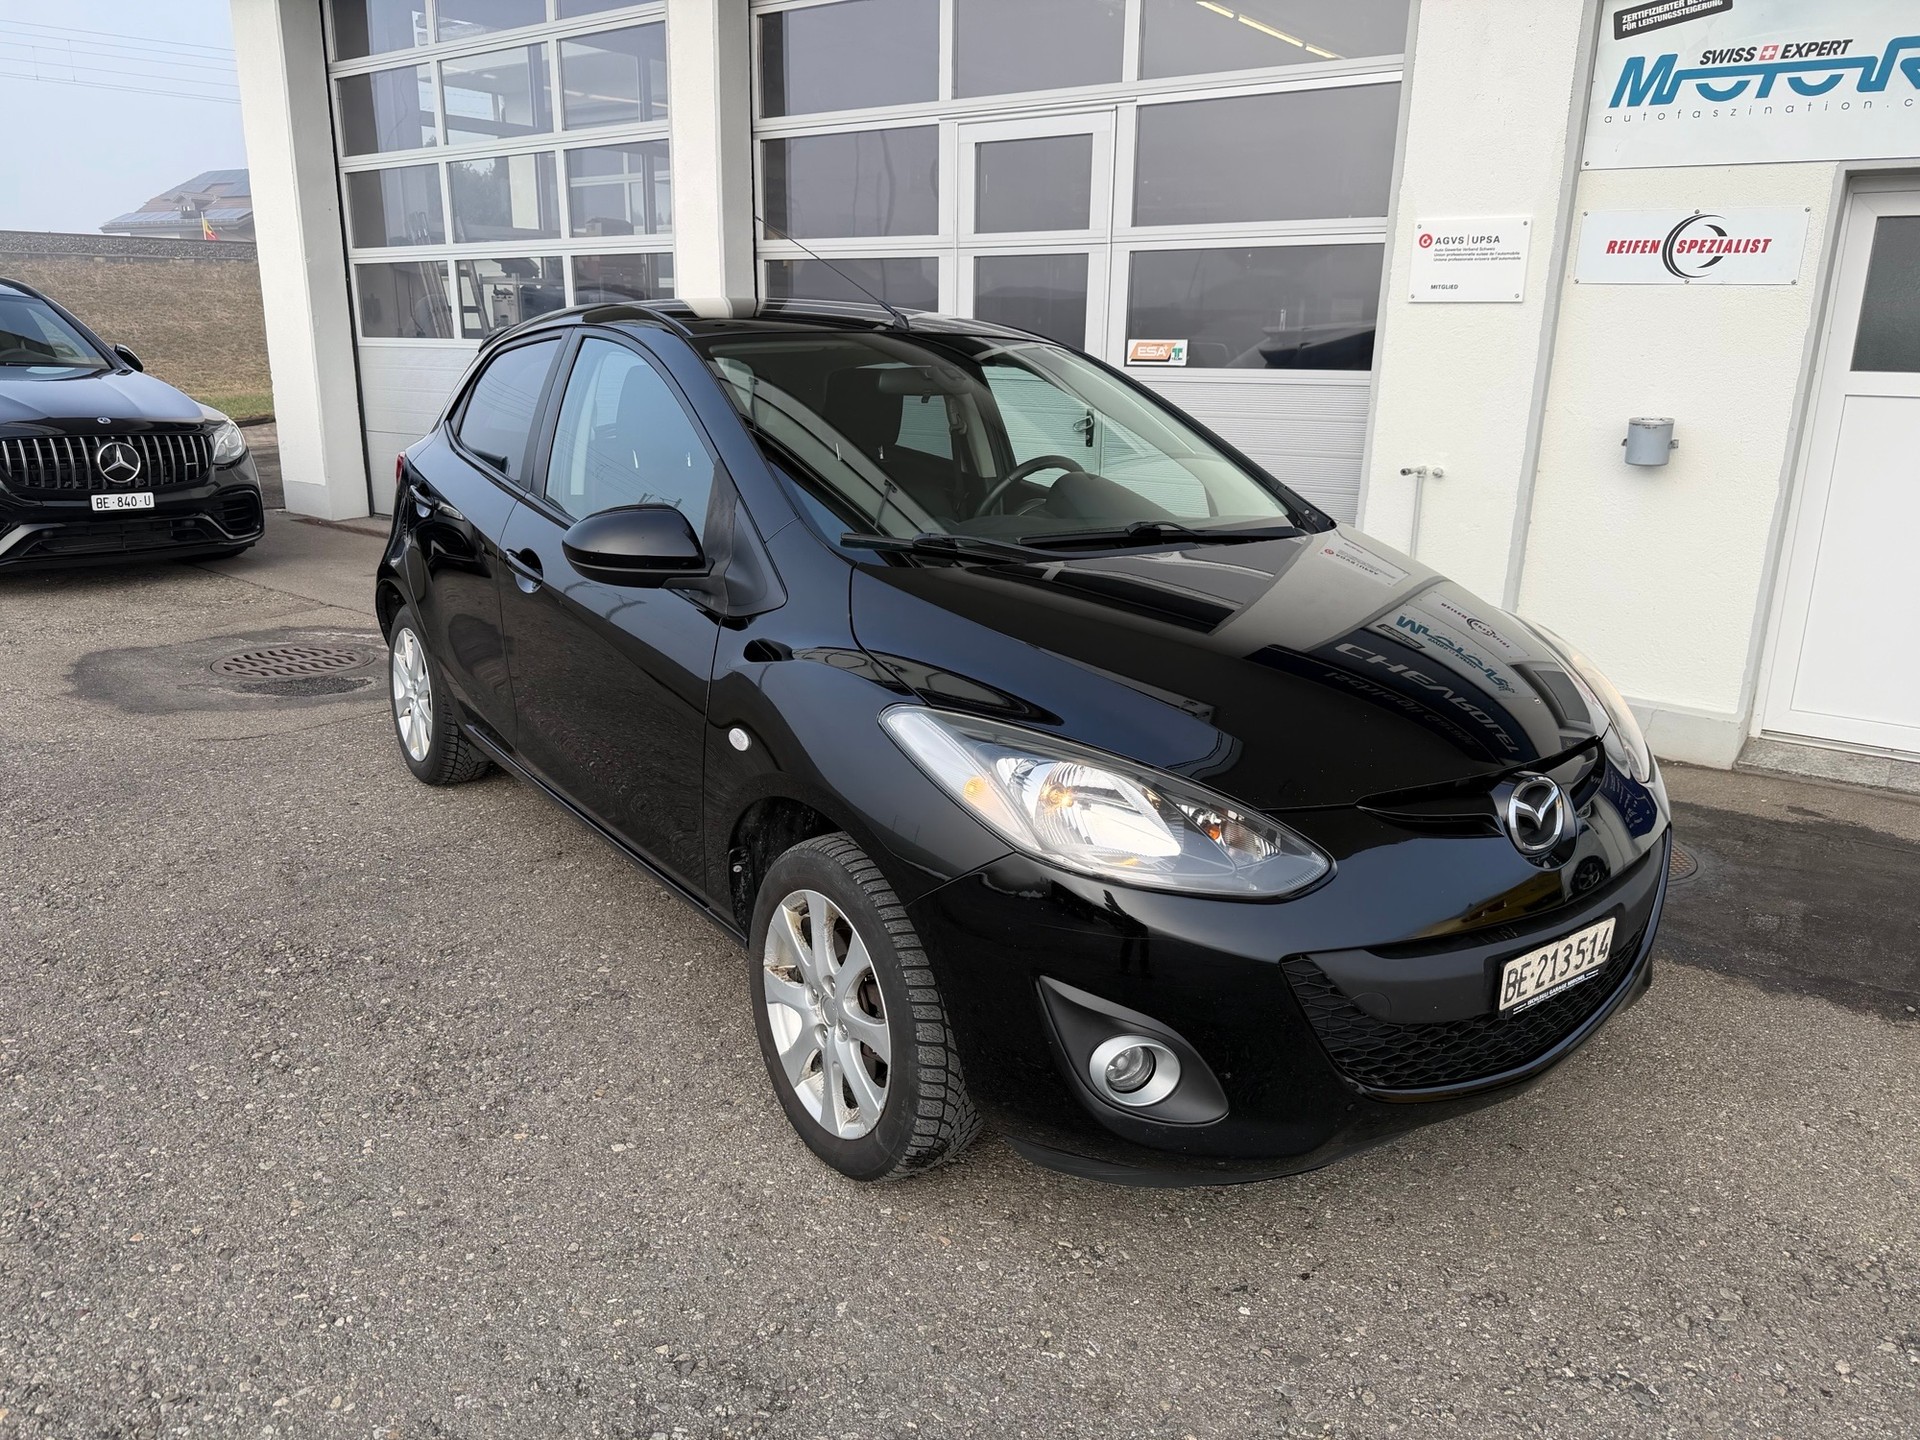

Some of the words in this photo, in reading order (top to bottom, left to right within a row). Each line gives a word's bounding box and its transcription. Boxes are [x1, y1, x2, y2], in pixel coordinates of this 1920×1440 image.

[1622, 0, 1685, 23] ZERTIFIZIERTER
[1622, 21, 1637, 32] FÜR
[1638, 0, 1723, 27] LEISTUNGSSTEIGERUNG
[1700, 46, 1757, 65] SWISS
[1780, 39, 1853, 59] EXPERT
[1605, 240, 1661, 254] REIFEN
[1676, 238, 1772, 254] SPEZIALIST
